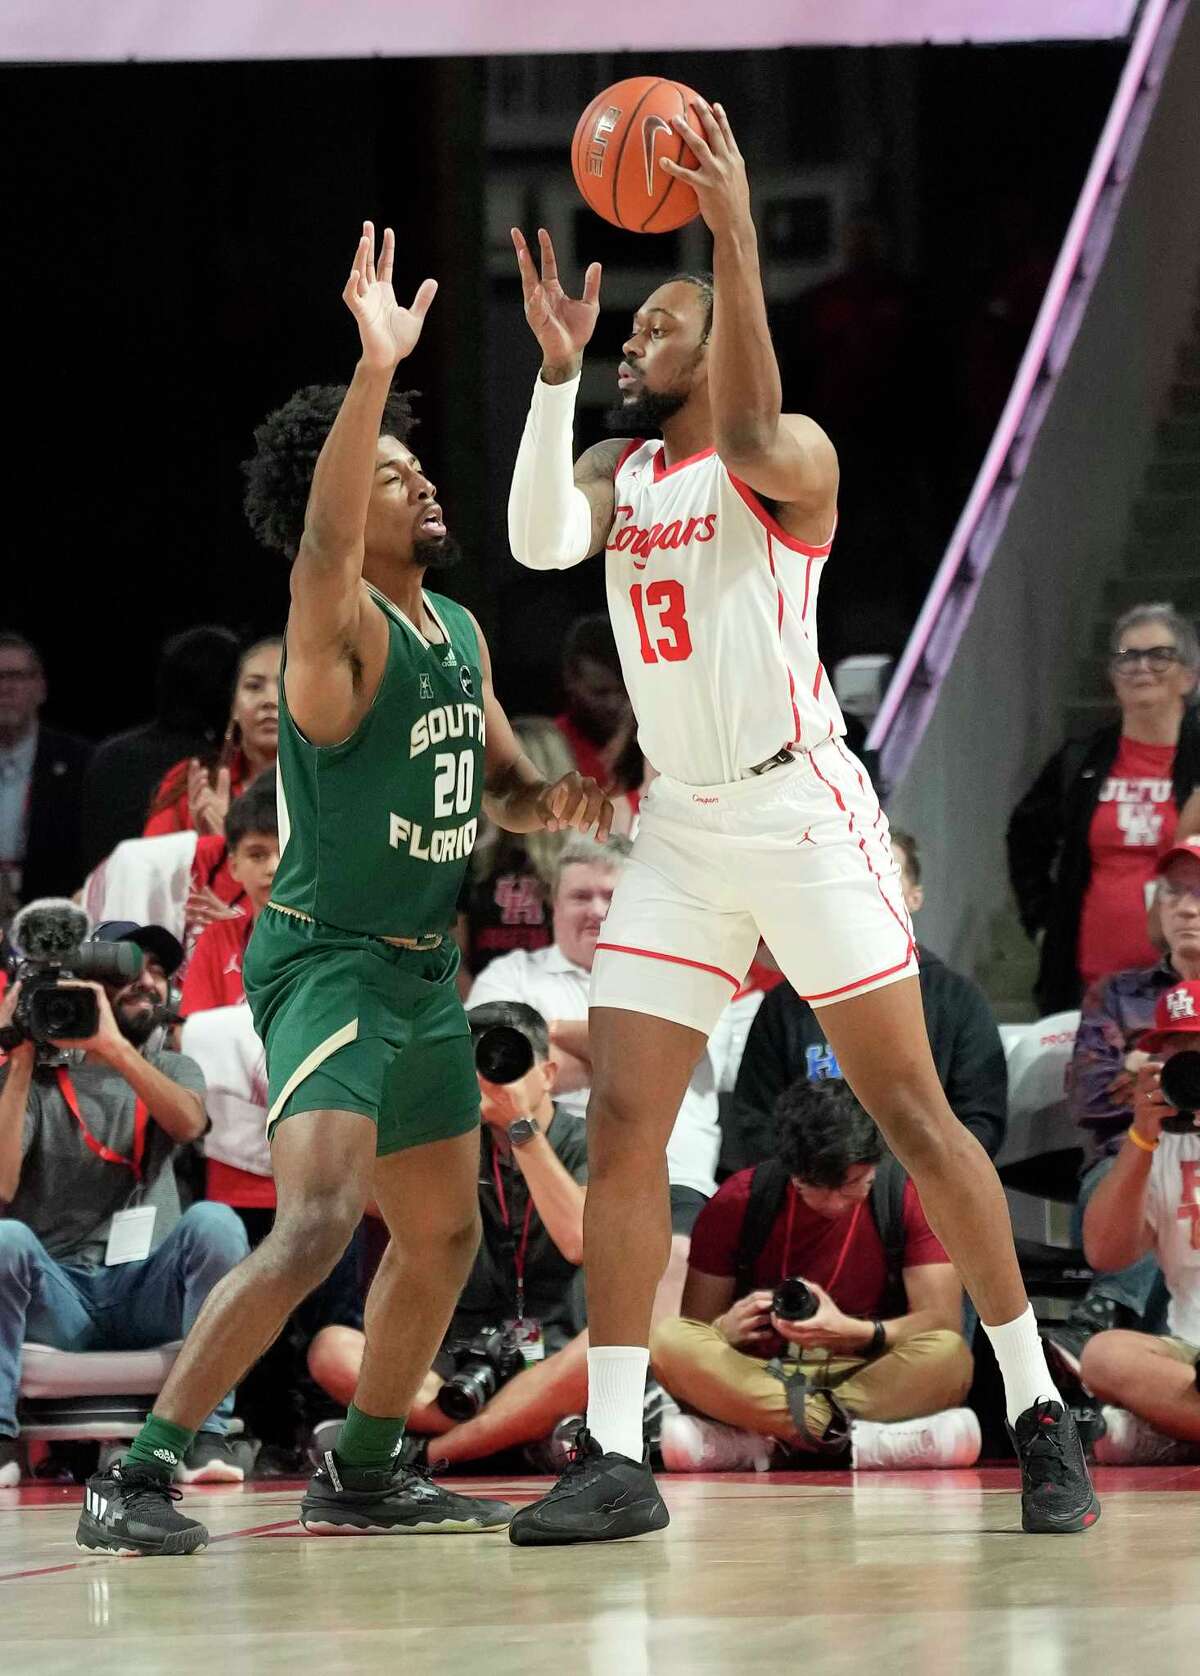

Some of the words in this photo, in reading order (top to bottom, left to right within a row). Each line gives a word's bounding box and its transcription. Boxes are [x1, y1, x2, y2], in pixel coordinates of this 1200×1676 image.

[629, 579, 693, 664] 13
[409, 703, 486, 760] SOUTH
[434, 749, 474, 818] 20
[389, 811, 478, 863] FLORID
